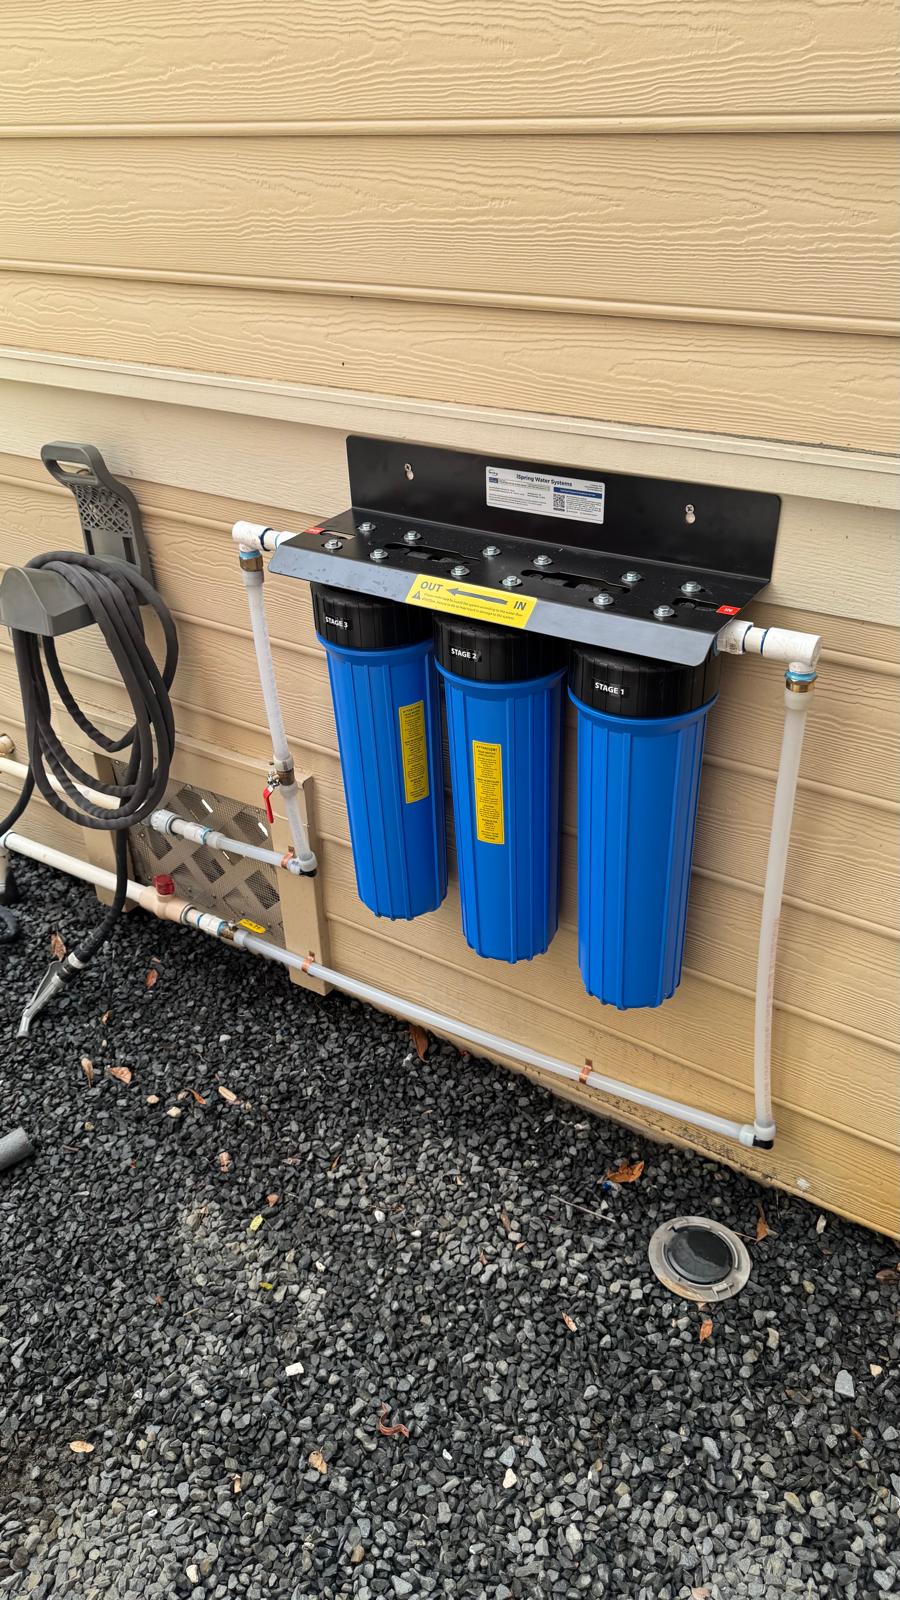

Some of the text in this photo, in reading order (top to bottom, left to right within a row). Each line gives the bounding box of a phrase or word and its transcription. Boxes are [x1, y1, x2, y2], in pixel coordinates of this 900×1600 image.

[551, 479, 572, 487] Systems
[421, 581, 443, 592] OUT
[513, 600, 527, 611] IN
[325, 616, 343, 627] STAGE
[451, 647, 478, 660] STAGE 2
[595, 682, 619, 695] STAGE
